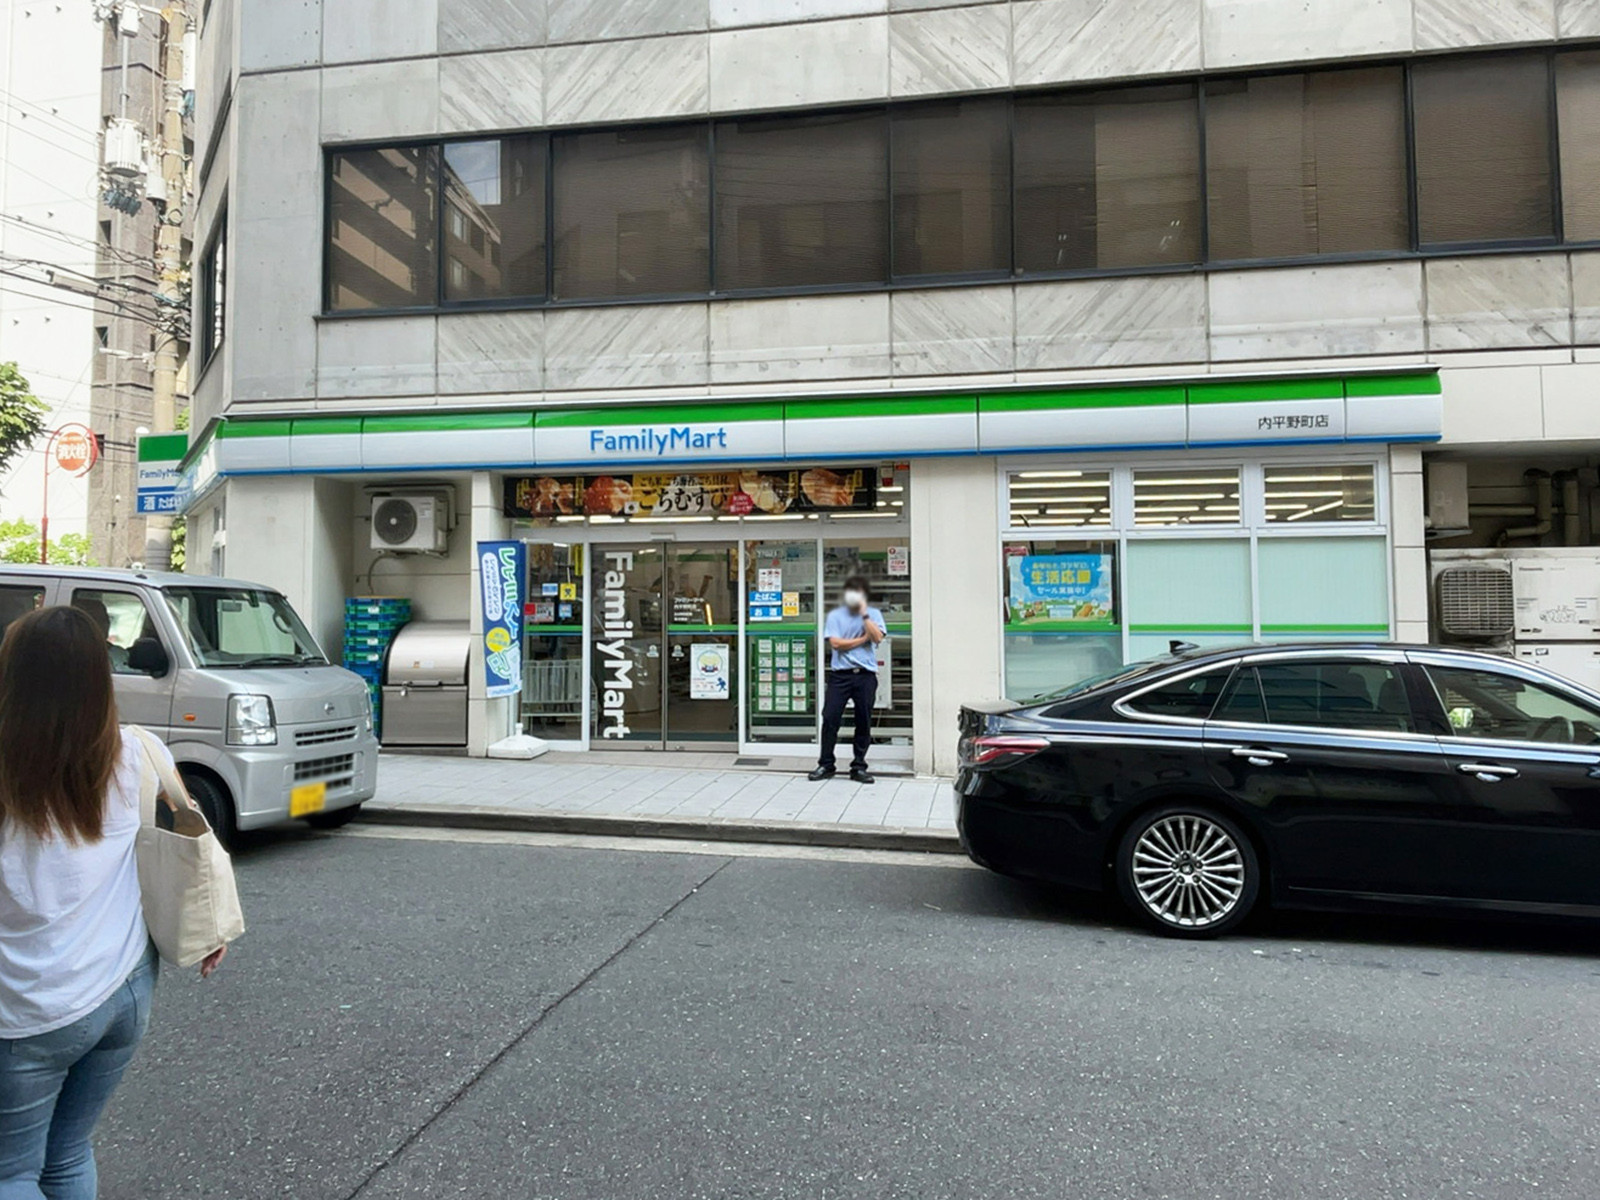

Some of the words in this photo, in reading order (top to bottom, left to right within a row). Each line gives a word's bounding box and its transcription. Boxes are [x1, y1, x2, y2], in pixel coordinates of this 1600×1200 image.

[1258, 415, 1329, 430] 内平野町店
[590, 427, 727, 455] FamilyMart
[640, 487, 728, 512] ごちむすび
[755, 593, 777, 601] たばこ
[596, 552, 633, 739] FamilyMart
